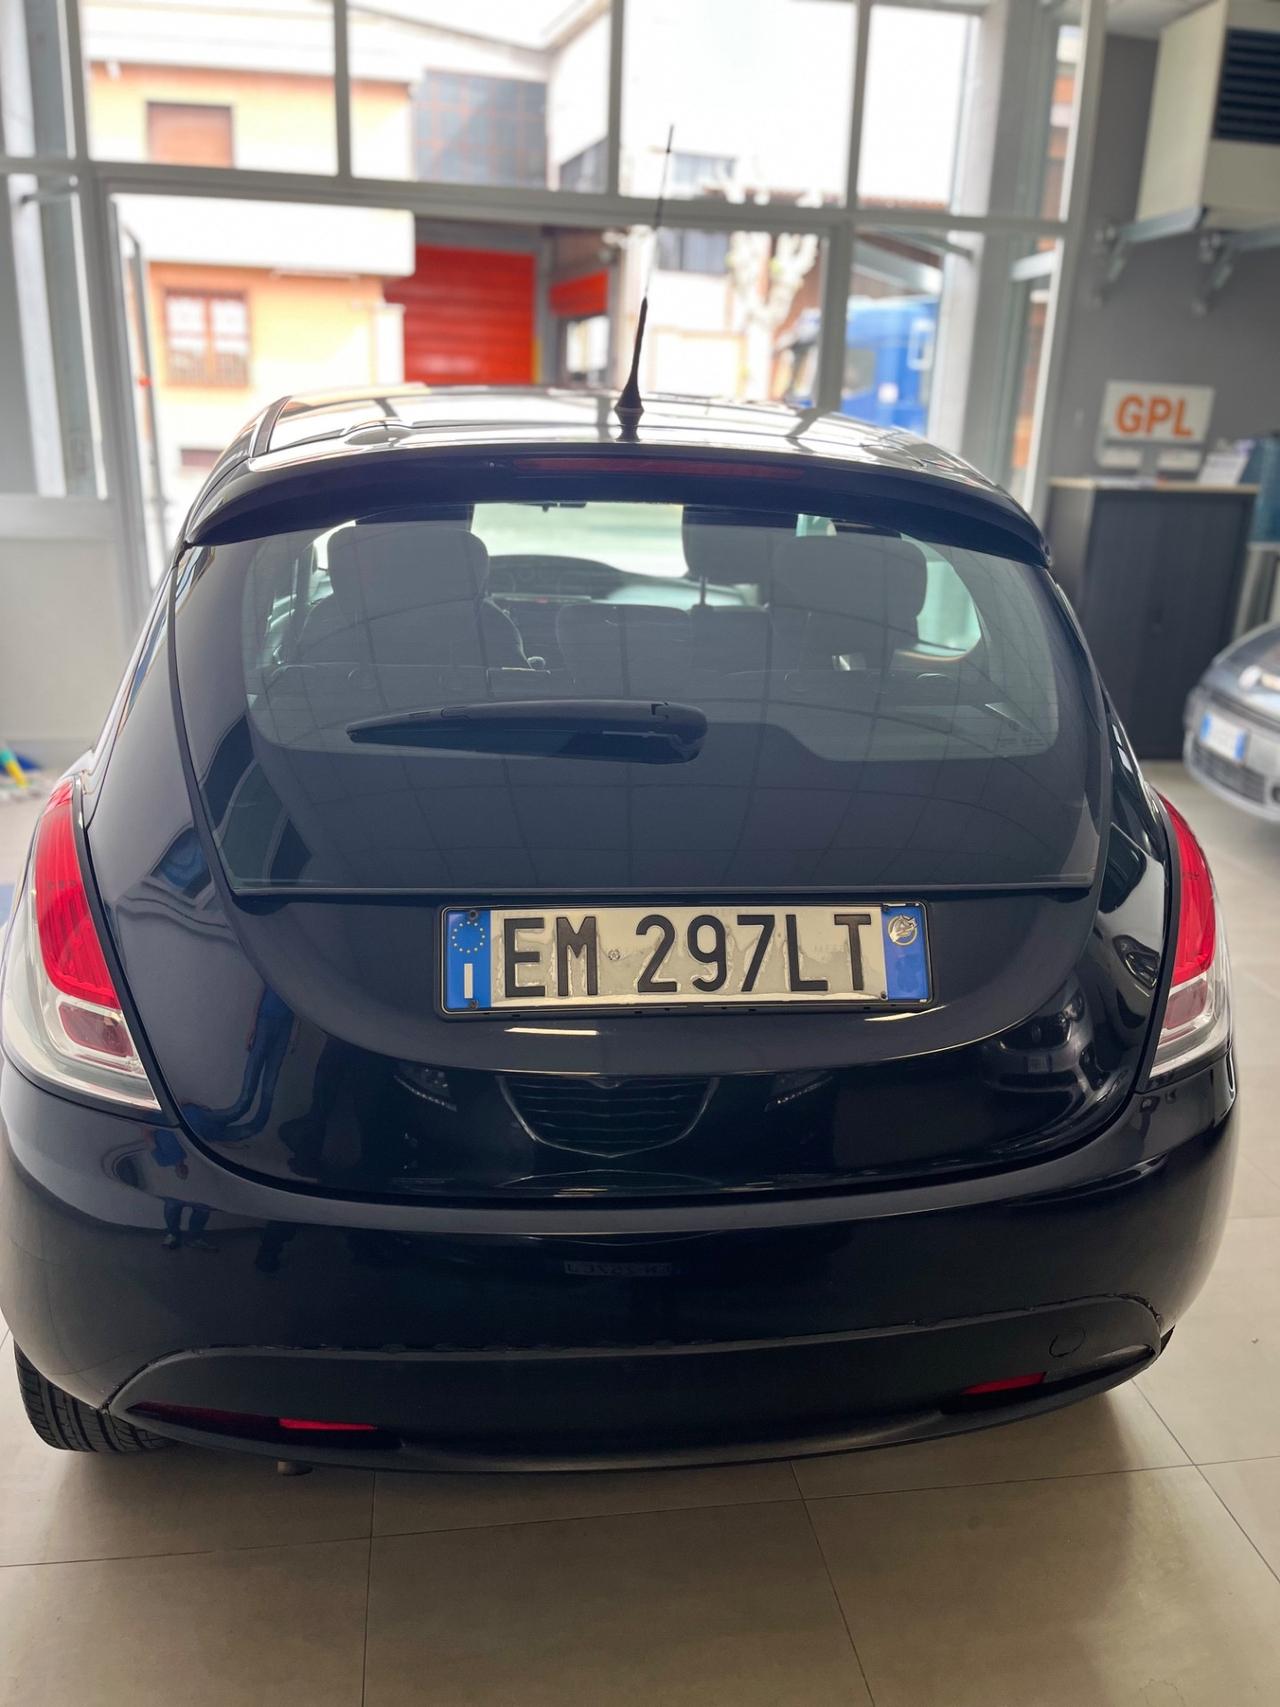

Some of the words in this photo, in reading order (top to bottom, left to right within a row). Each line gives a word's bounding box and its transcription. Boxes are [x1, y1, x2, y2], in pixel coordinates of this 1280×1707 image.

[1114, 394, 1194, 437] GPL
[503, 916, 599, 998] EM
[635, 913, 872, 993] 297LT
[463, 963, 474, 999] I
